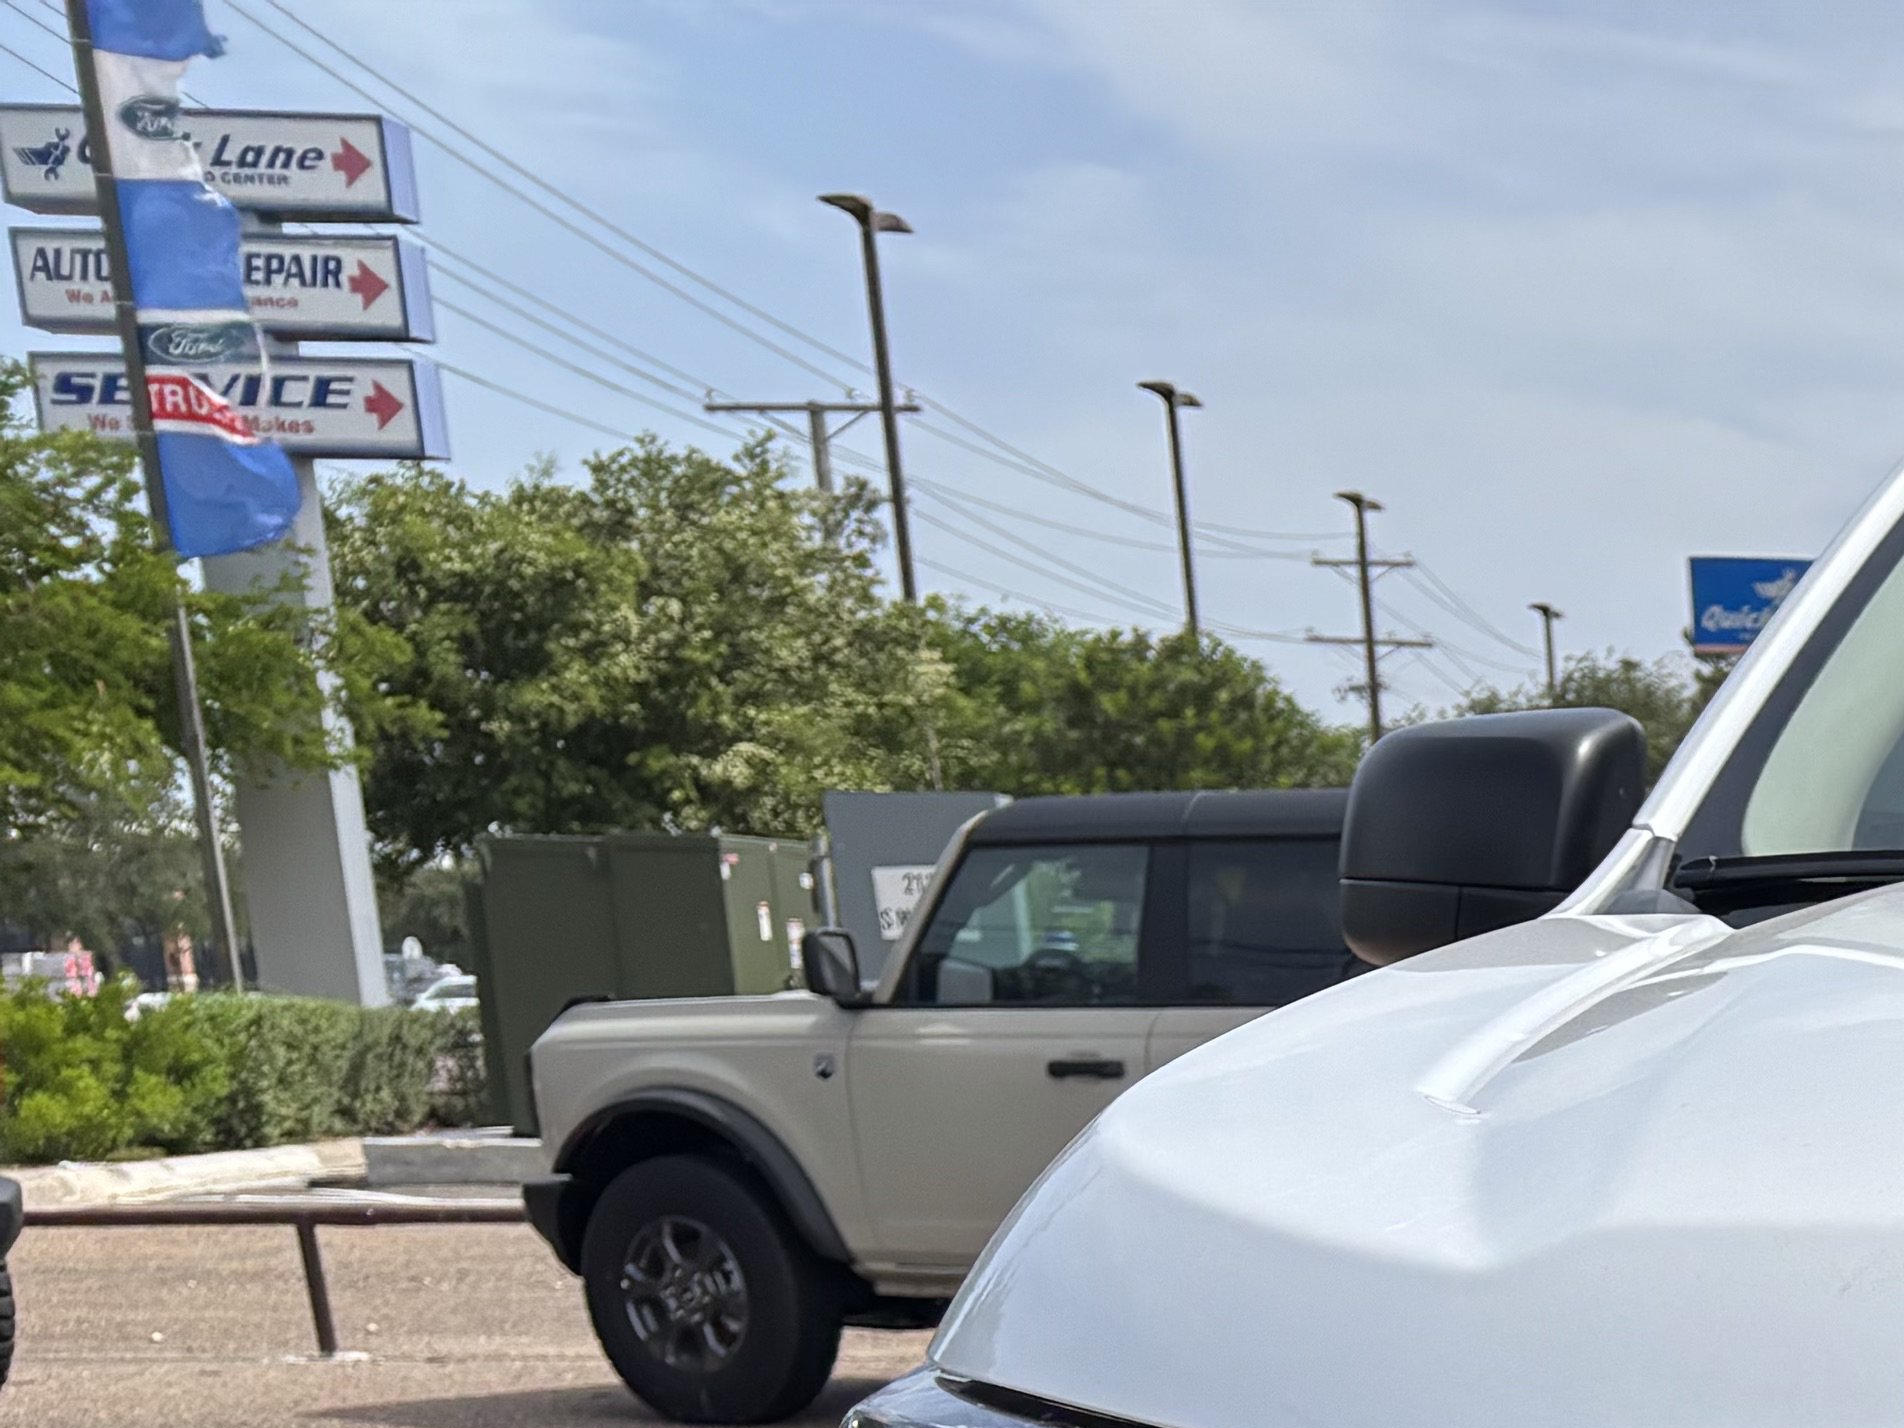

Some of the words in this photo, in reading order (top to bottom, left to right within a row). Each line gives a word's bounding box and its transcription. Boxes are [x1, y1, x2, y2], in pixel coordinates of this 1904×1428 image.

[210, 134, 325, 171] Lane
[220, 171, 290, 185] CENTER
[30, 247, 111, 282] AUTO
[243, 252, 342, 288] EPAIR
[50, 371, 355, 408] SEVICE
